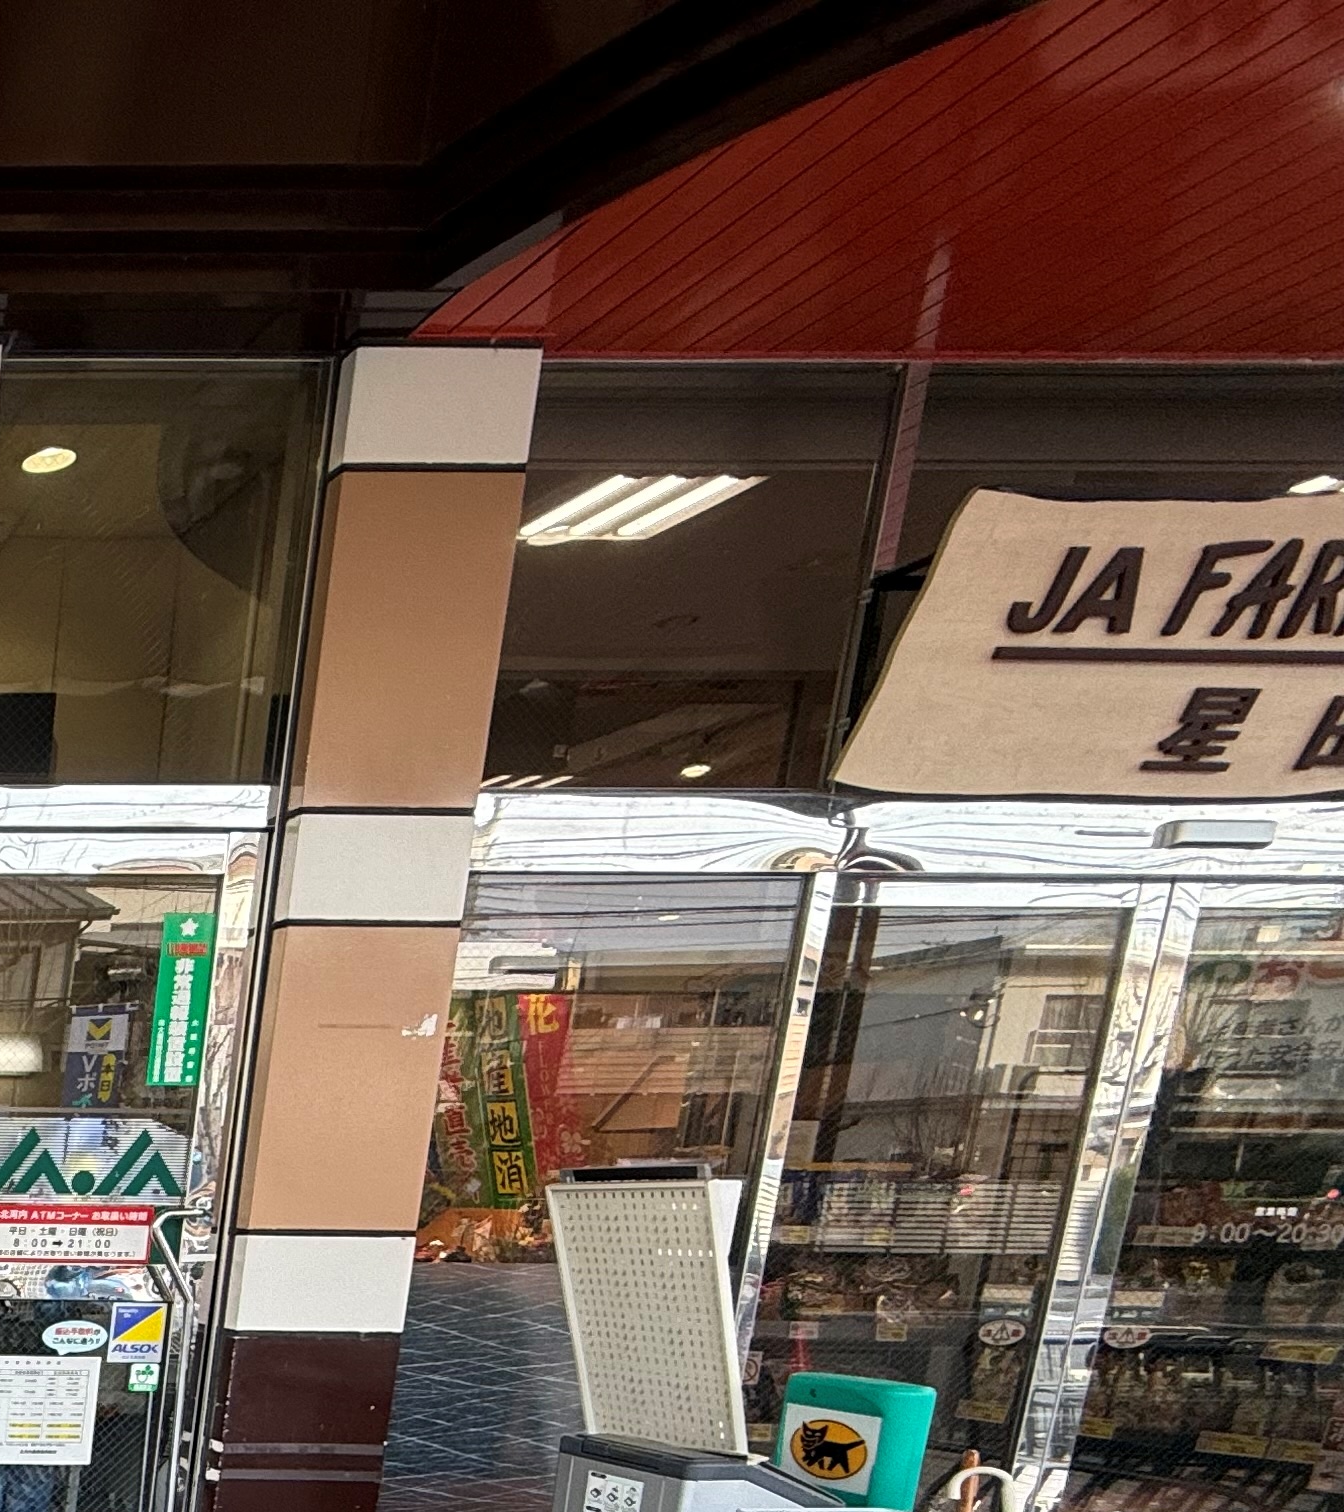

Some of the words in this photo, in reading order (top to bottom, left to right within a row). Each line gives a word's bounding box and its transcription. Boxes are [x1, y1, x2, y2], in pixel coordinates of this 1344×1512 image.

[1007, 546, 1145, 634] JA
[1161, 539, 1344, 639] FAR
[30, 1210, 88, 1221] ATMコーナー
[112, 1343, 159, 1353] ALSOK
